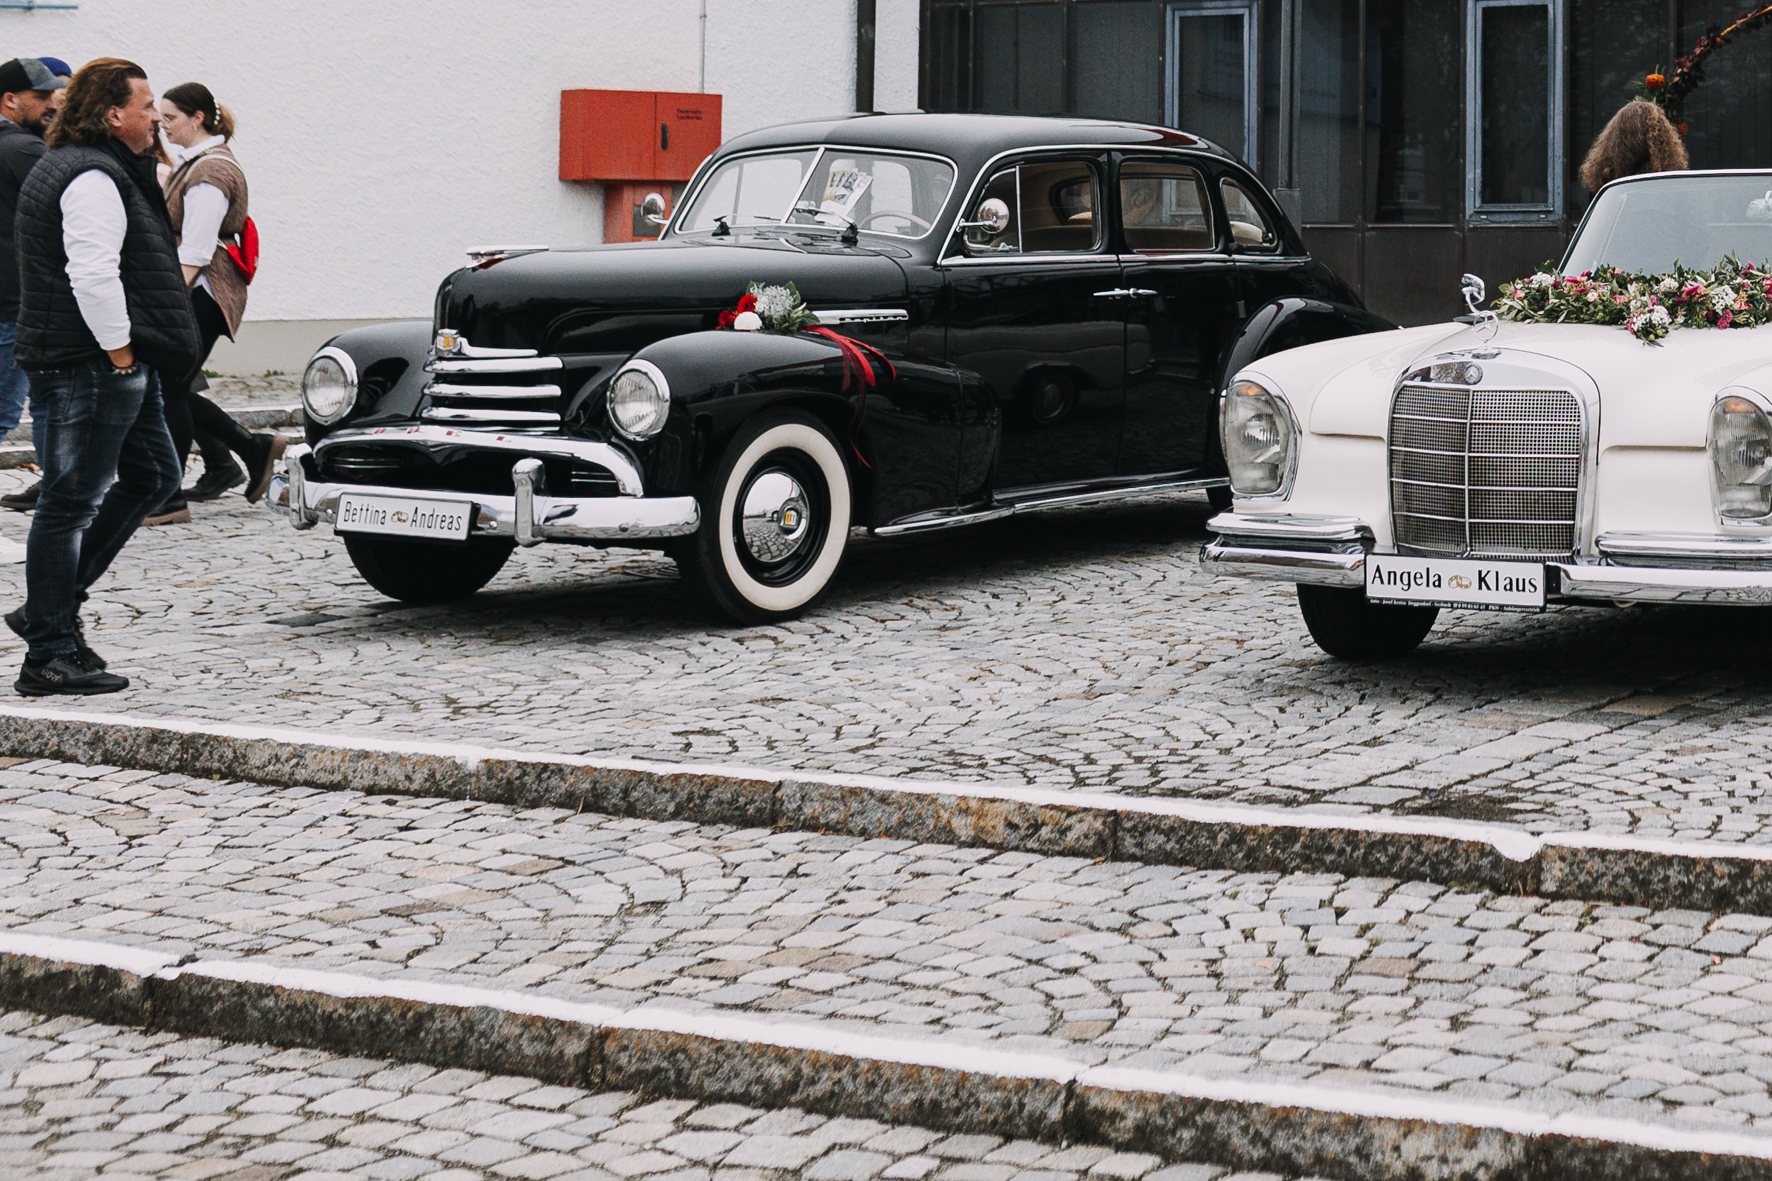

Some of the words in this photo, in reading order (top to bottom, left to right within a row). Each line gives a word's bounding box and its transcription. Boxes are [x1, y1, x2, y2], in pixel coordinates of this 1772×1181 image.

[343, 501, 387, 525] Bettina
[410, 506, 463, 531] Andreas
[1371, 564, 1442, 592] Angela
[1477, 569, 1538, 593] Klaus
